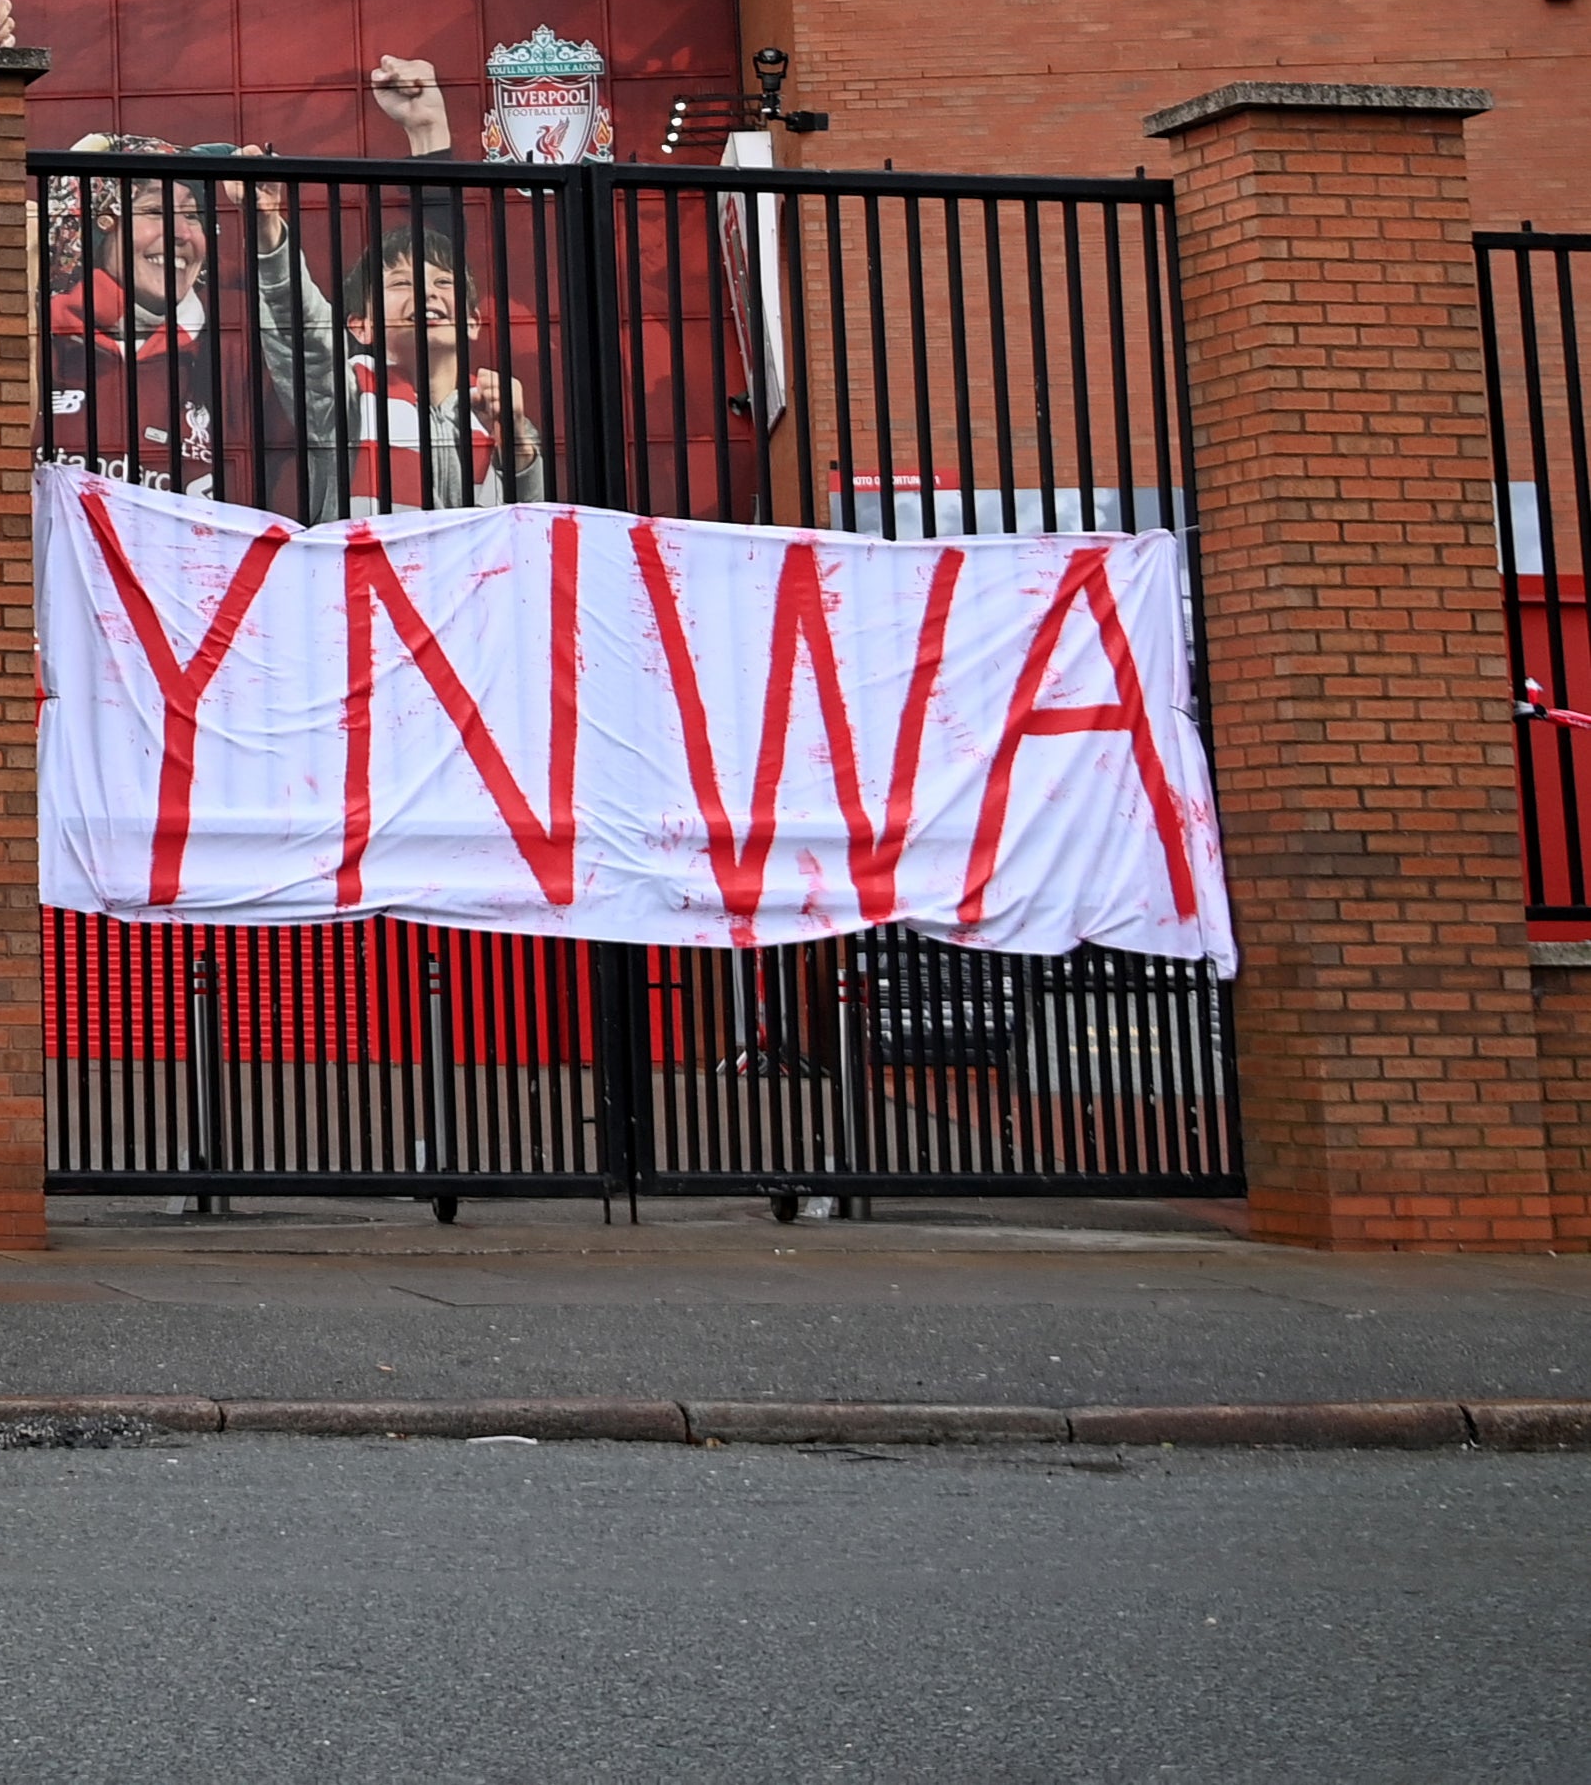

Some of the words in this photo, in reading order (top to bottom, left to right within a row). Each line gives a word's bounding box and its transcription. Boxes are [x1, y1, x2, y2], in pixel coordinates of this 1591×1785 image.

[518, 64, 545, 75] NEVER
[545, 63, 570, 73] WALK
[572, 62, 601, 72] ALONE
[503, 89, 589, 106] LIVERPOOL
[506, 107, 557, 118] FOOTBALL
[560, 105, 586, 116] CLUB
[78, 492, 1196, 943] YNWA
